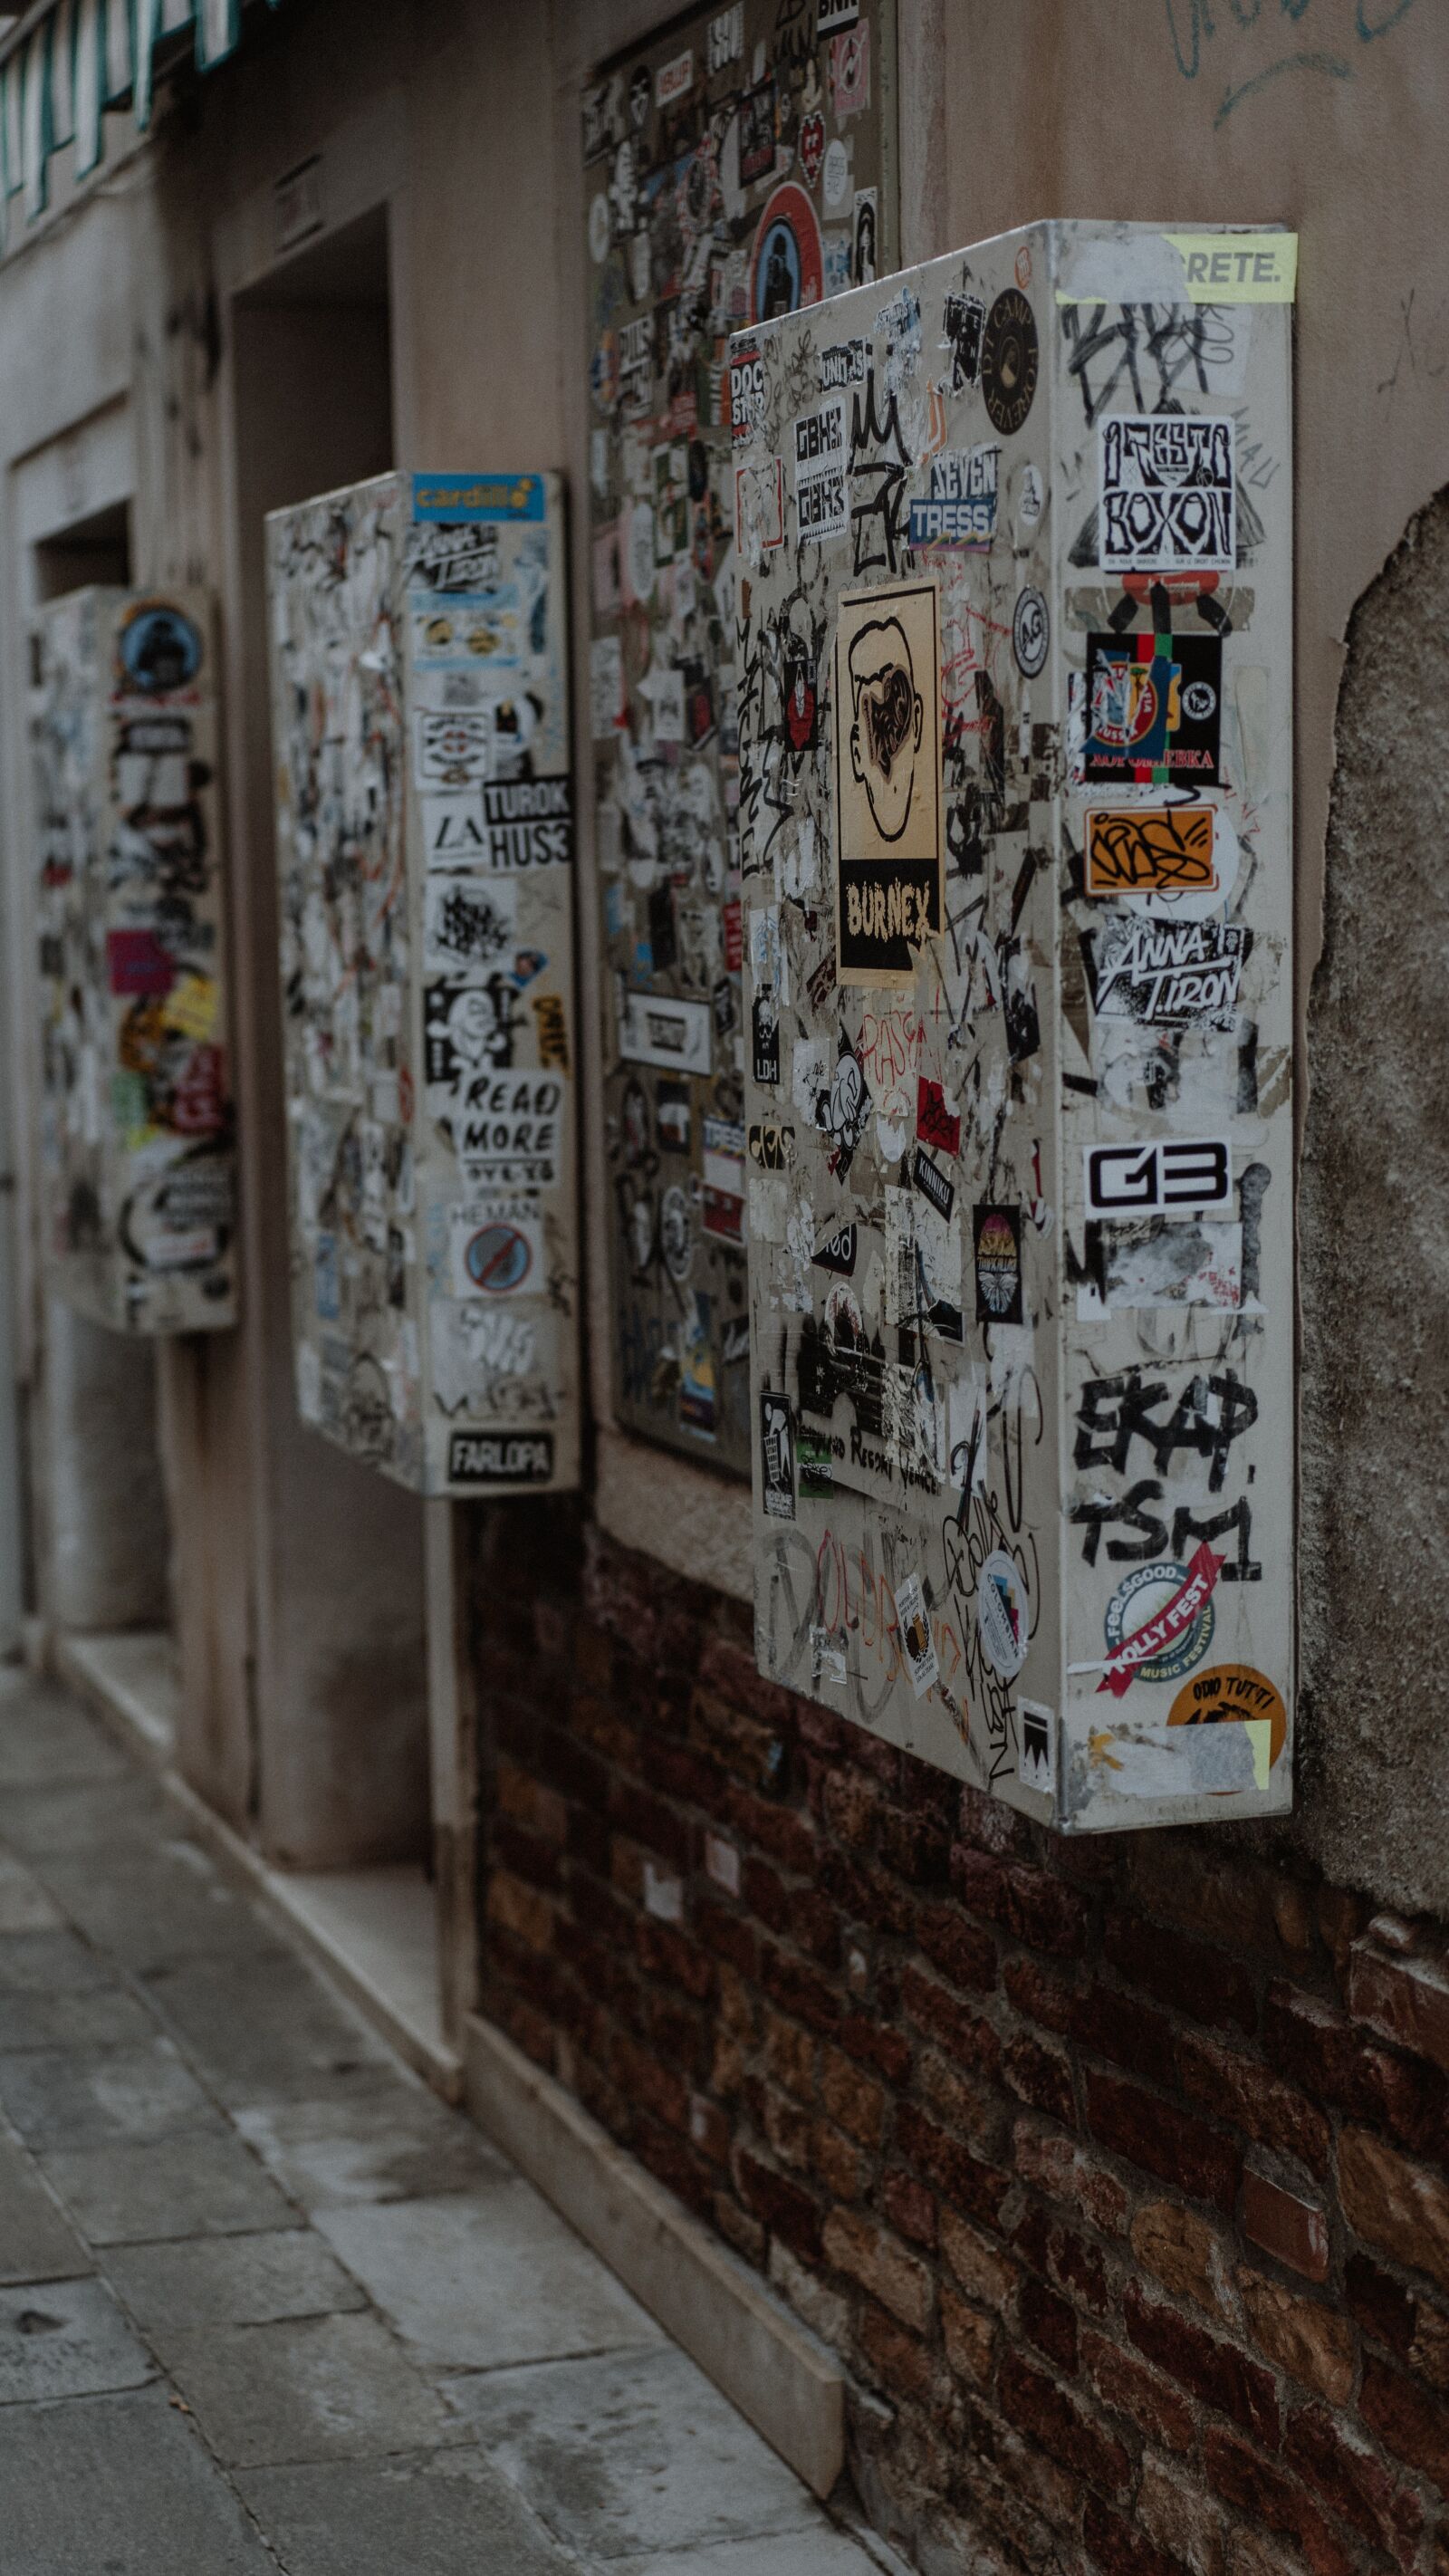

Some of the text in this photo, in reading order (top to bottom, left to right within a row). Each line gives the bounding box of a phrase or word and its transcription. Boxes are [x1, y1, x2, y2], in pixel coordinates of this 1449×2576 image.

[731, 360, 763, 398] DOC
[934, 449, 996, 500] SEVEN
[911, 504, 990, 538] TRESS
[1103, 490, 1232, 555] BOXON
[487, 781, 570, 820] TUROK
[489, 822, 570, 867] HUS3
[846, 877, 931, 943] BURNEX
[1095, 926, 1212, 1008] ANNA
[757, 1058, 777, 1081] LDH
[465, 1077, 561, 1117] READ
[463, 1122, 554, 1153] MORE
[919, 1157, 952, 1207] KINNIKU
[1089, 1142, 1229, 1208] G3
[451, 1438, 550, 1475] FARLOPA
[986, 1572, 1019, 1658] COLOMBIAN
[1166, 1573, 1209, 1629] FEST
[1139, 1664, 1181, 1679] MUSIC
[1183, 1604, 1212, 1668] FESTIVAL
[1193, 1677, 1276, 1710] ODIO TUTTI
